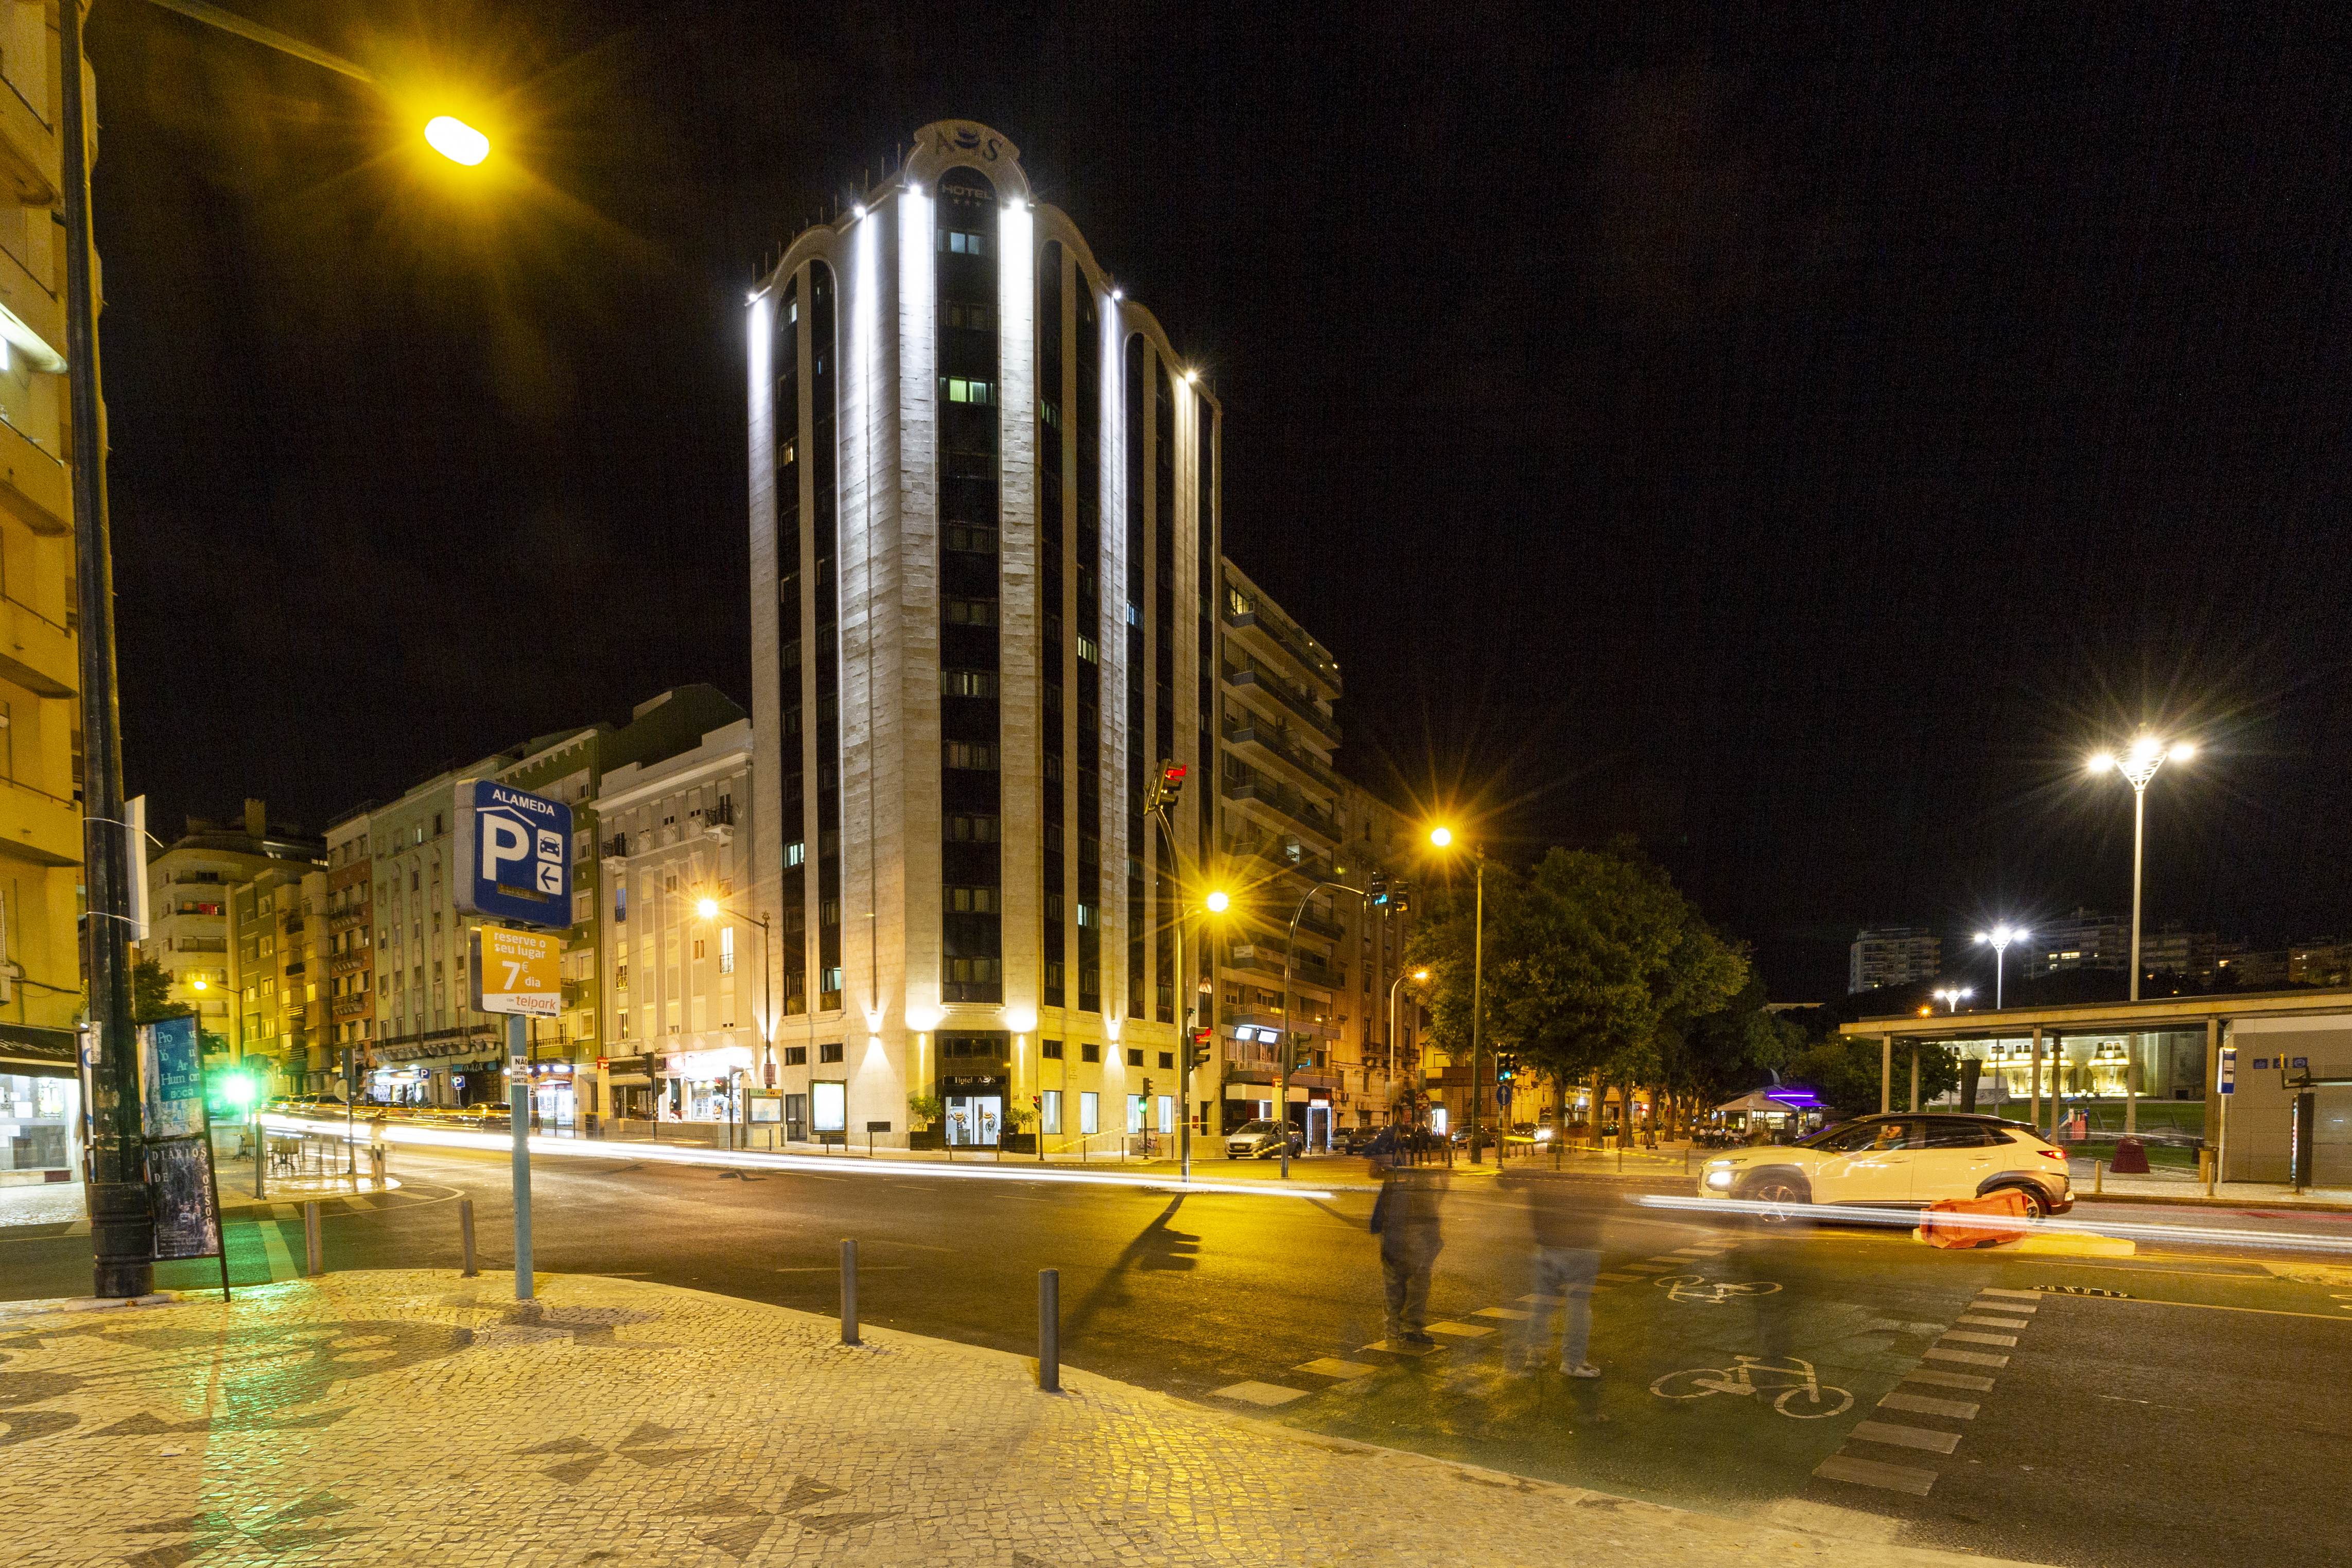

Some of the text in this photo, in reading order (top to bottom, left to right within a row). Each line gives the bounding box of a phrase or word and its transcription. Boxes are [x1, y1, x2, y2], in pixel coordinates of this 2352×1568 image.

[942, 184, 992, 200] HOTEL
[492, 789, 555, 816] ALAMEDA
[483, 813, 529, 881] P
[494, 932, 546, 948] reserve o
[494, 944, 546, 960] seu lugar
[502, 961, 520, 990] 7
[525, 977, 541, 987] dia
[516, 996, 556, 1010] telpark
[421, 1069, 428, 1078] P
[454, 1077, 462, 1086] P
[152, 1147, 207, 1160] DIÁRIOS
[154, 1173, 169, 1182] DE
